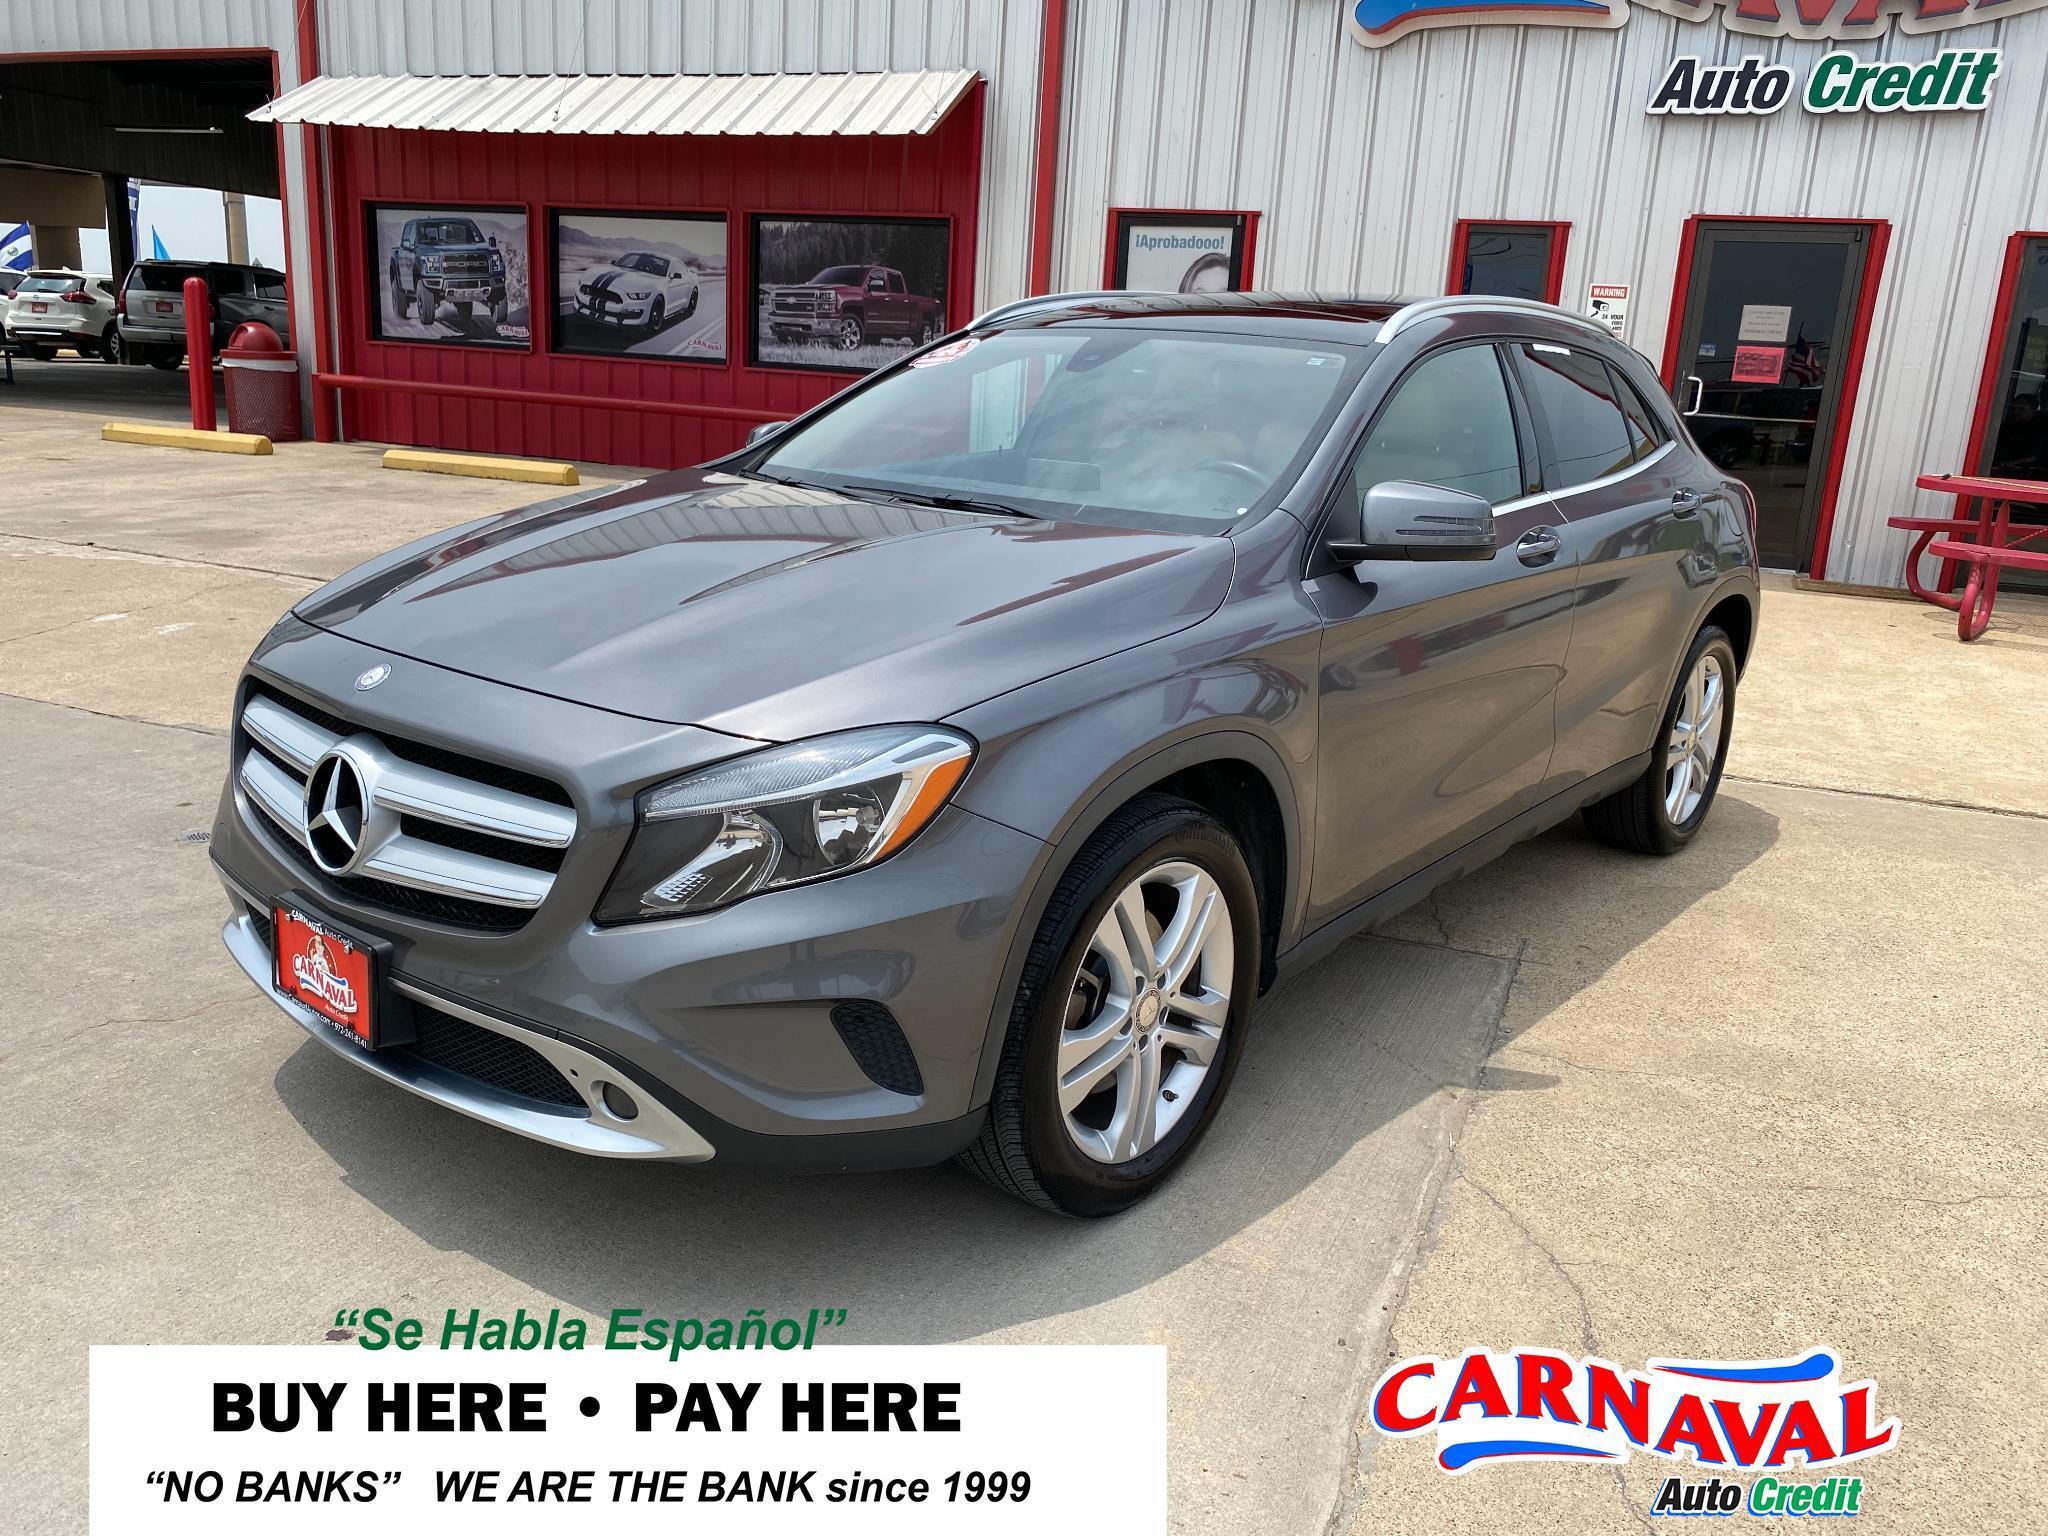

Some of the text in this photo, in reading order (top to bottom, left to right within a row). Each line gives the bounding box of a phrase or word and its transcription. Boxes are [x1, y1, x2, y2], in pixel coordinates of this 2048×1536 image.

[1654, 52, 1996, 109] Auto Credit
[1136, 234, 1225, 251] ¡Aprobadooo!
[1593, 288, 1625, 297] WARNING
[291, 910, 324, 935] CARNAVAL
[293, 954, 356, 1010] CARNAVAL
[334, 1023, 367, 1049] 972-241-8141
